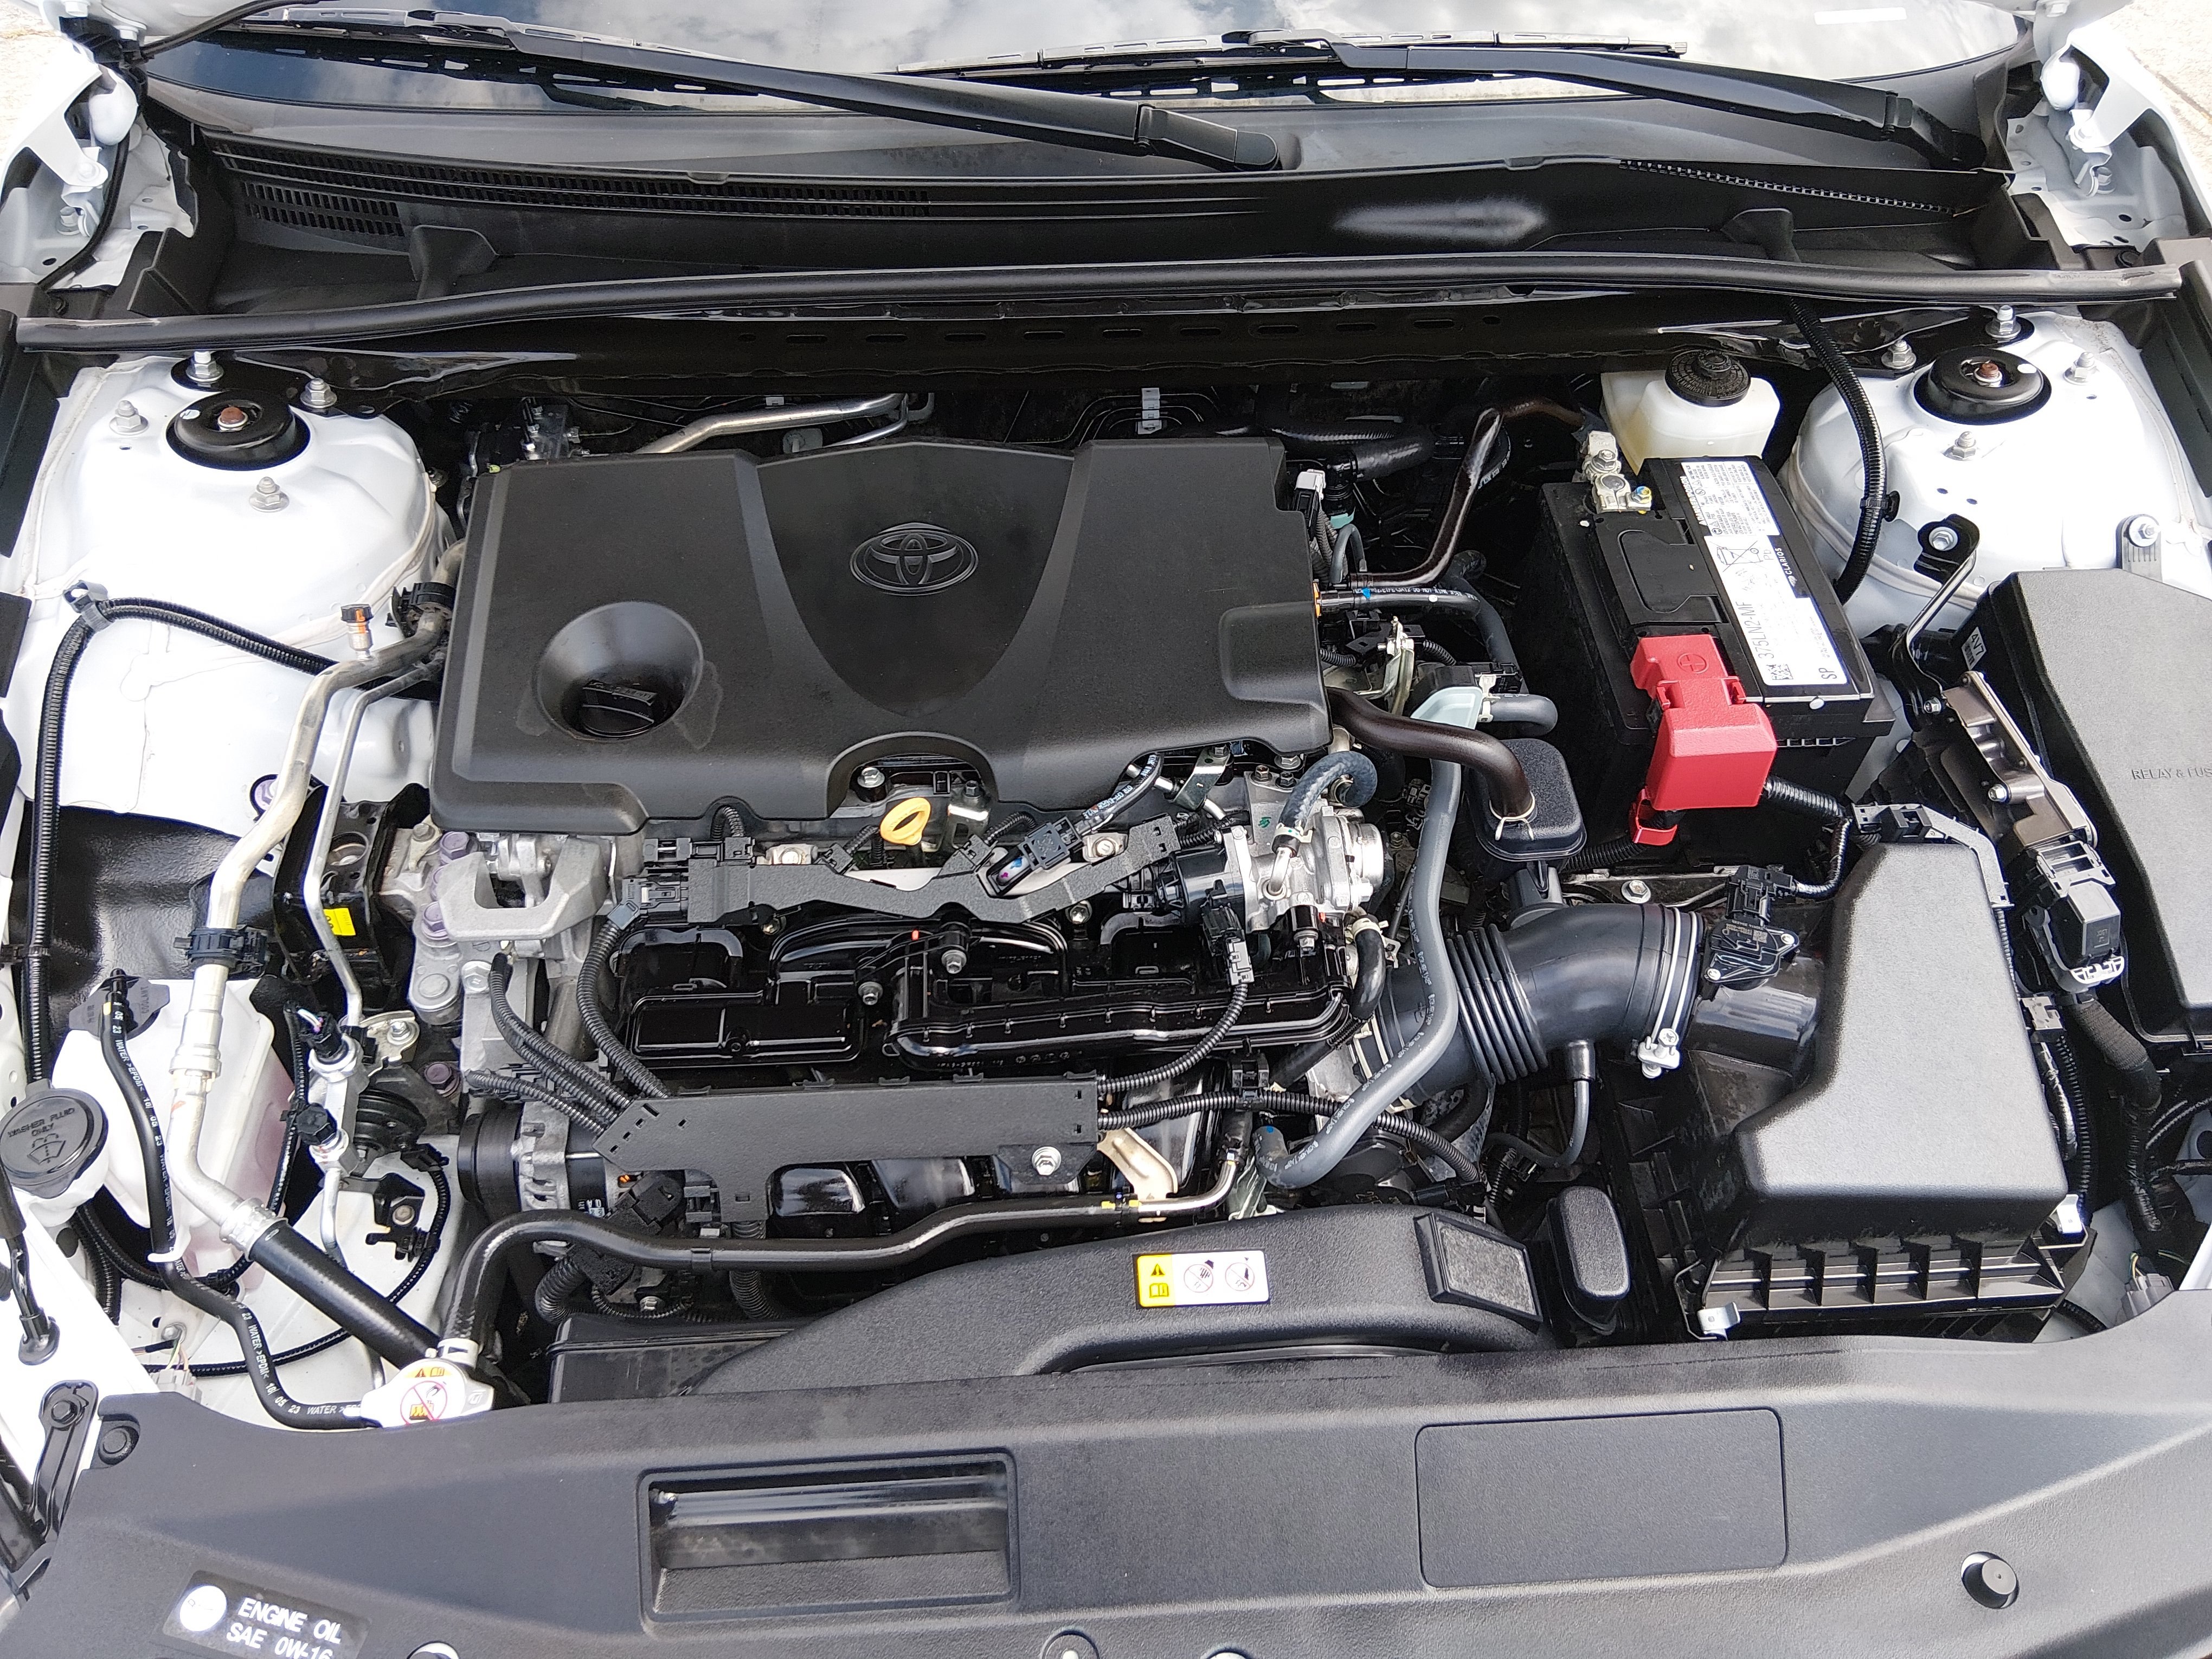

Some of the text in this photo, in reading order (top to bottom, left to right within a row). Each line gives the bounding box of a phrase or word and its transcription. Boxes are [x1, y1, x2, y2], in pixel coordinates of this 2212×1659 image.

[1775, 548, 1792, 575] CLARIOS
[1735, 601, 1774, 659] 375LN2-MF
[1971, 633, 1984, 656] 4V7
[1818, 667, 1837, 680] SP
[2131, 768, 2171, 779] RELAY
[2176, 768, 2186, 778] &
[112, 1025, 122, 1034] 23
[114, 1039, 130, 1062] WATER
[8, 1108, 75, 1137] WASHER FLUID
[31, 1123, 54, 1137] ONLY
[248, 1324, 263, 1351] WATER
[288, 1405, 301, 1414] 23
[306, 1405, 337, 1415] WATER
[237, 1597, 342, 1644] ENGINE OIL
[226, 1622, 333, 1659] SAE 0W-16
